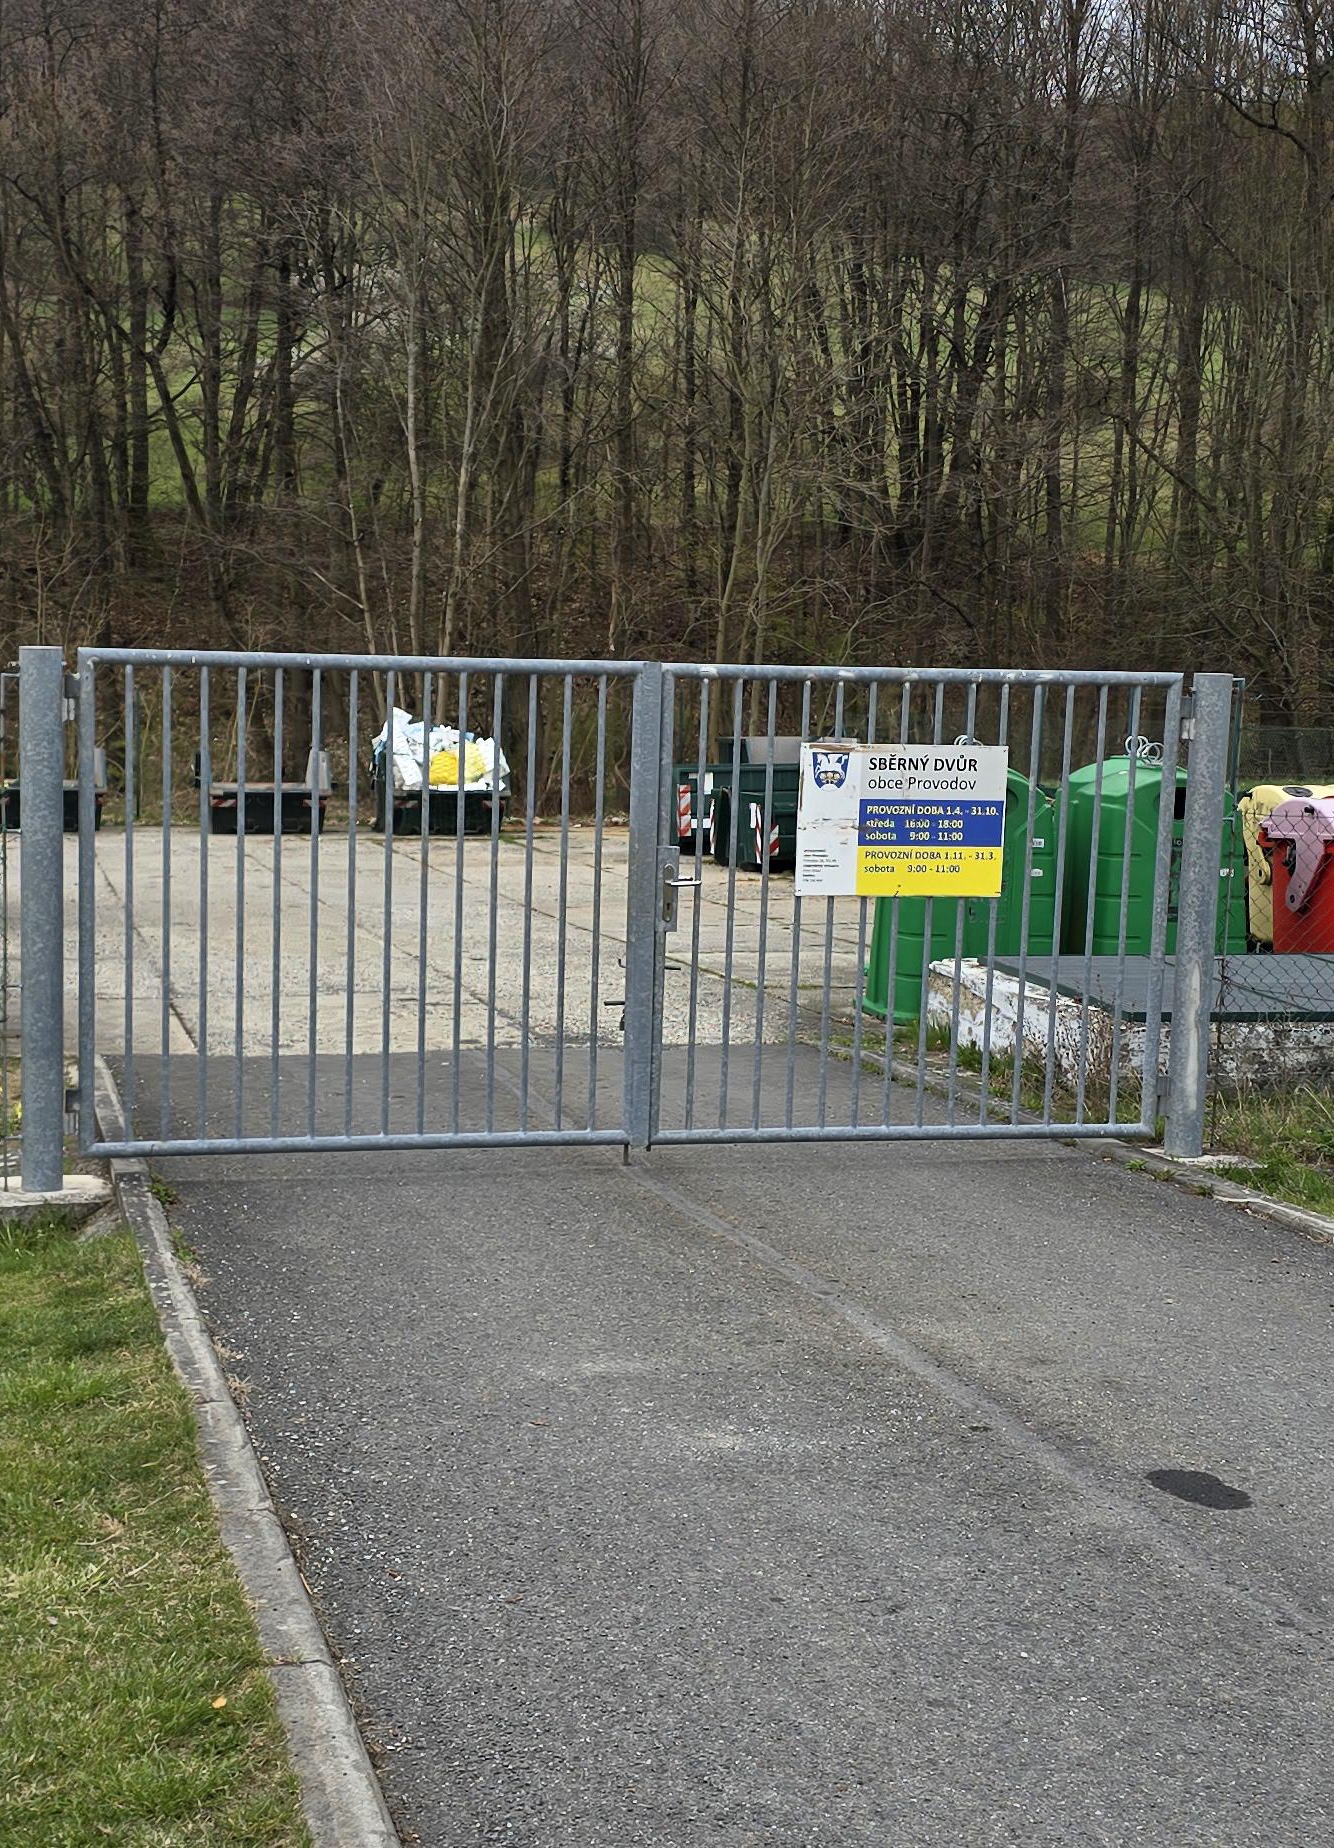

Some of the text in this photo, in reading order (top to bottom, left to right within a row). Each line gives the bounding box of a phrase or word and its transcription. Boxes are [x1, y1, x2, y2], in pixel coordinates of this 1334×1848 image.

[868, 754, 978, 772] SBĚRNÝ DVŮR
[868, 776, 977, 790] obce Provodov
[866, 803, 915, 815] PROVOZNÍ
[917, 806, 944, 815] DOBA
[970, 806, 999, 816] 31.10.
[865, 831, 897, 840] sobota
[937, 832, 964, 841] 11:00
[864, 849, 913, 859] PROVOZNÍ
[914, 852, 942, 860] DOBA
[864, 864, 895, 873] sobota
[907, 865, 927, 873] 9:00
[935, 865, 961, 873] 11:00
